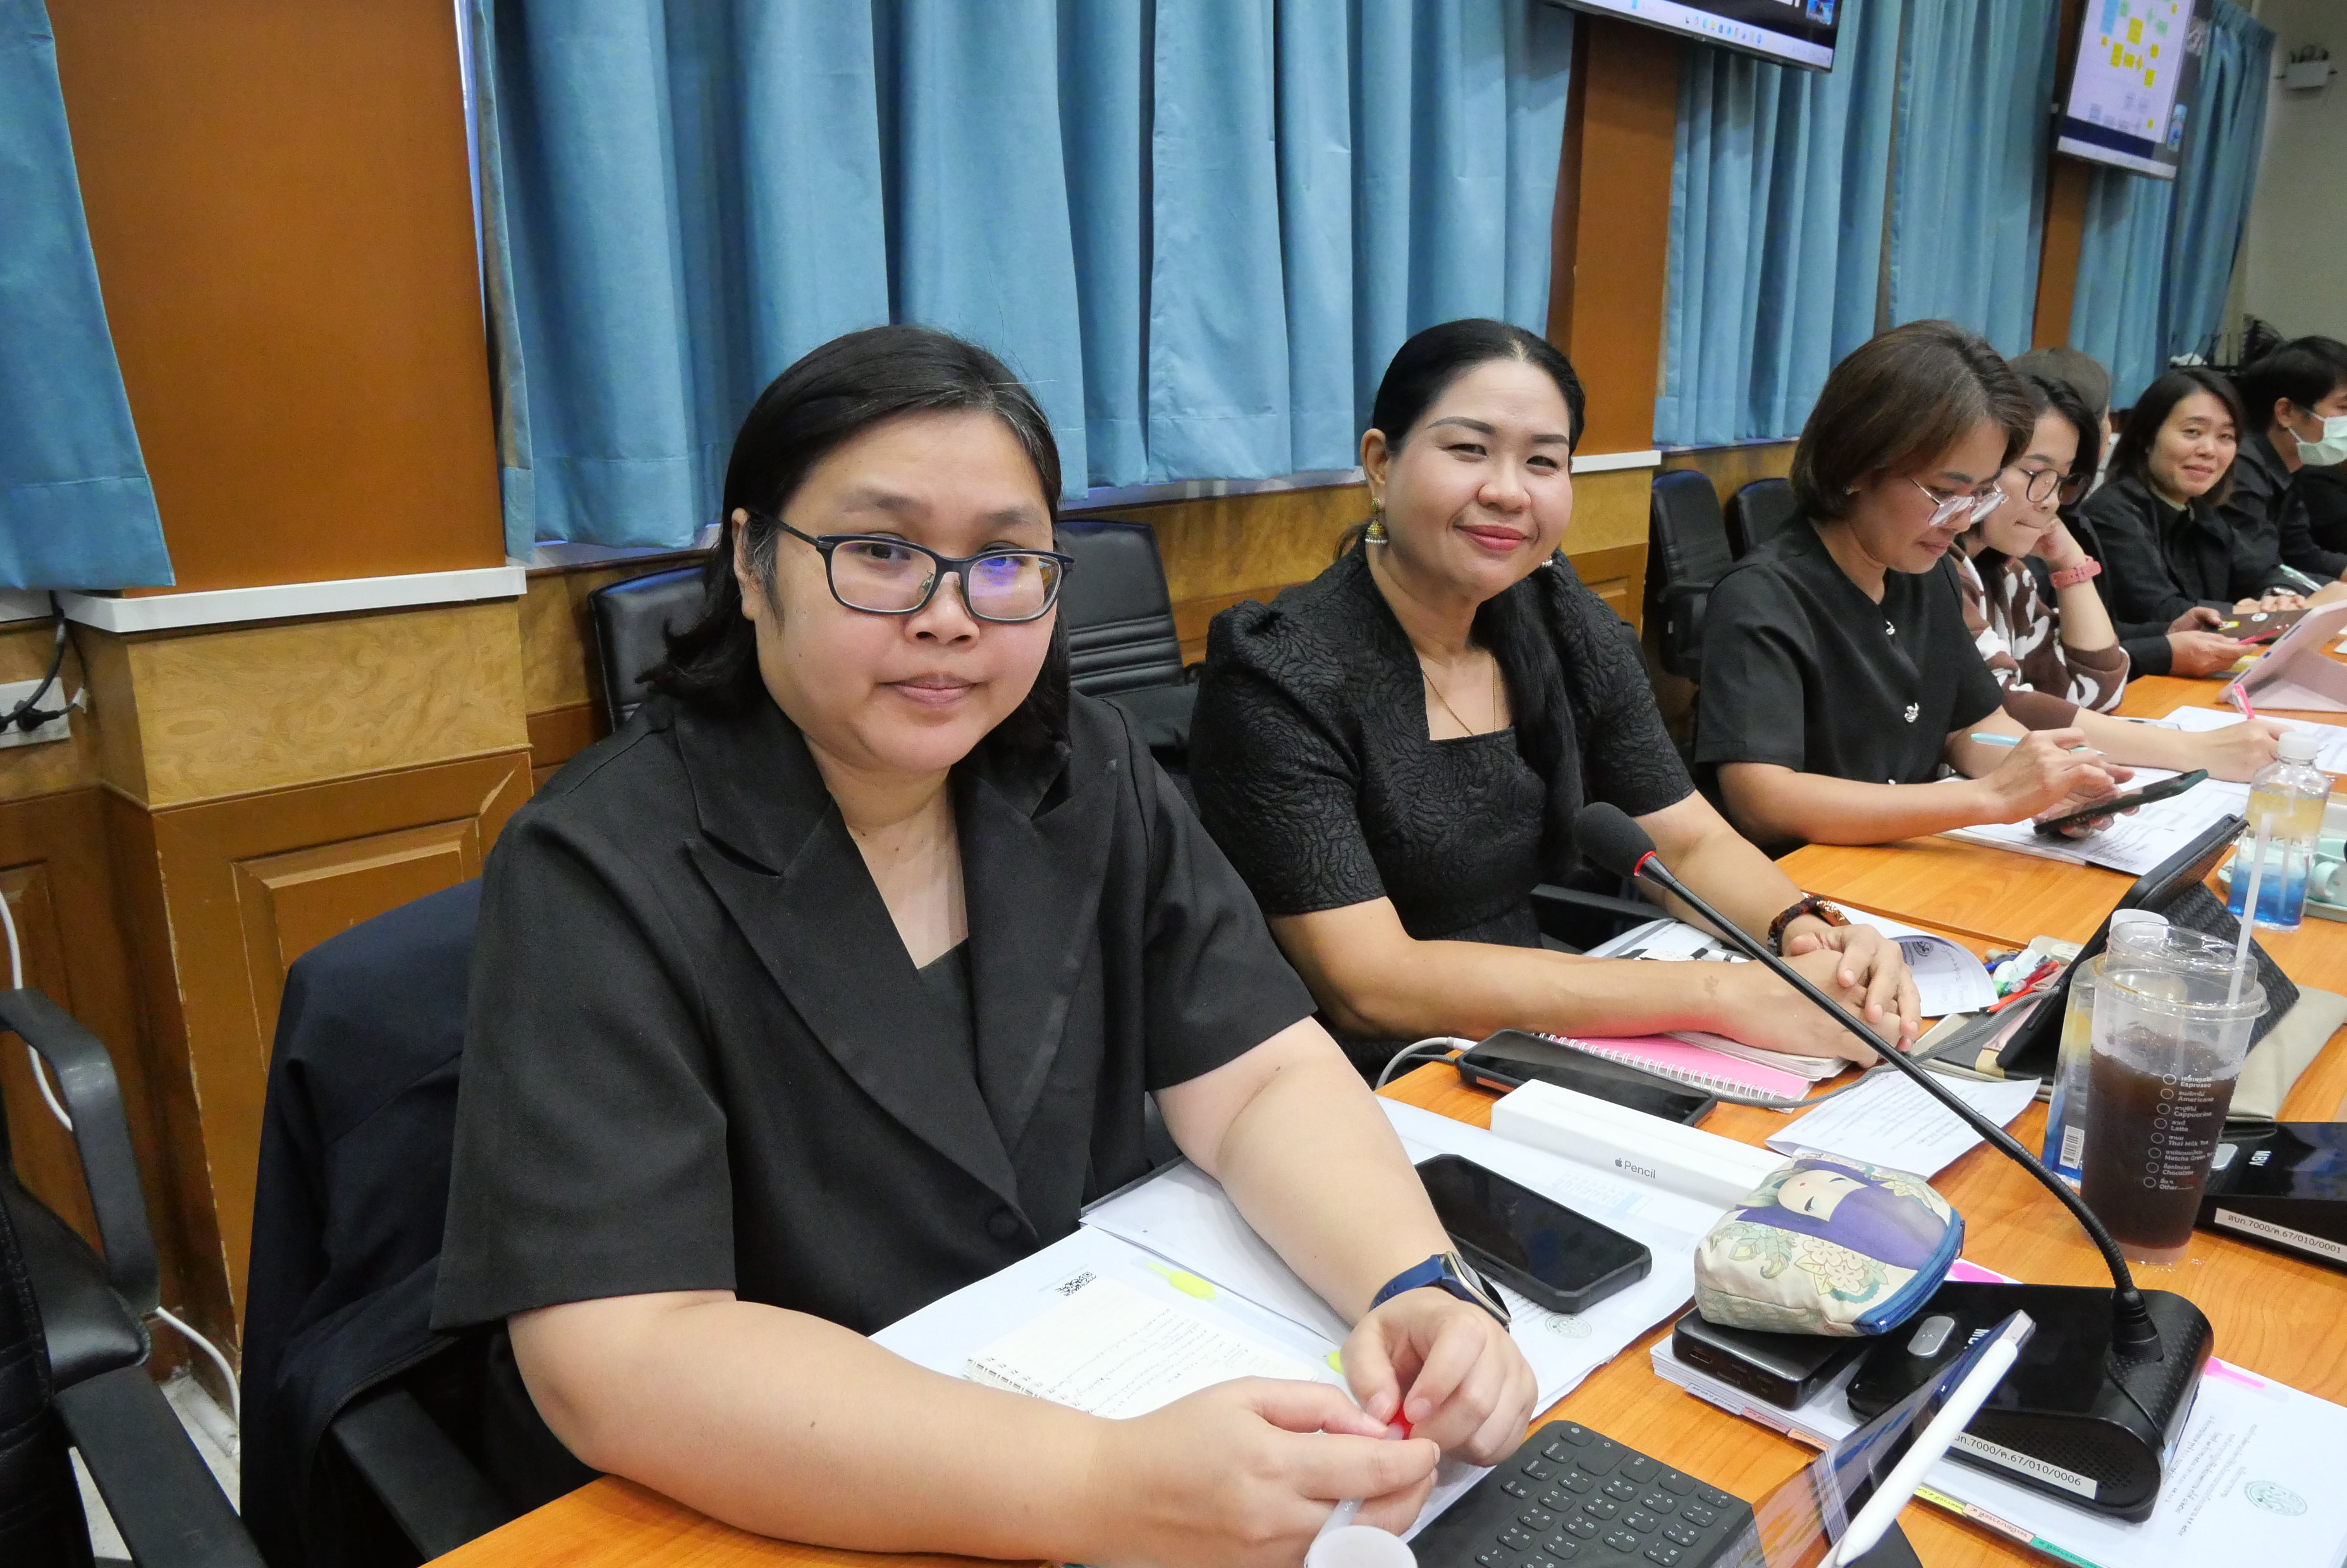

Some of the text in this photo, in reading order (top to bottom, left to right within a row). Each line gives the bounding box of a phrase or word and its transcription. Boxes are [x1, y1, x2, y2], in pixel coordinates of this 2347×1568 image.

[2248, 1149, 2272, 1167] MBV
[1624, 1160, 1656, 1179] Pencil
[1526, 1461, 1538, 1471] option
